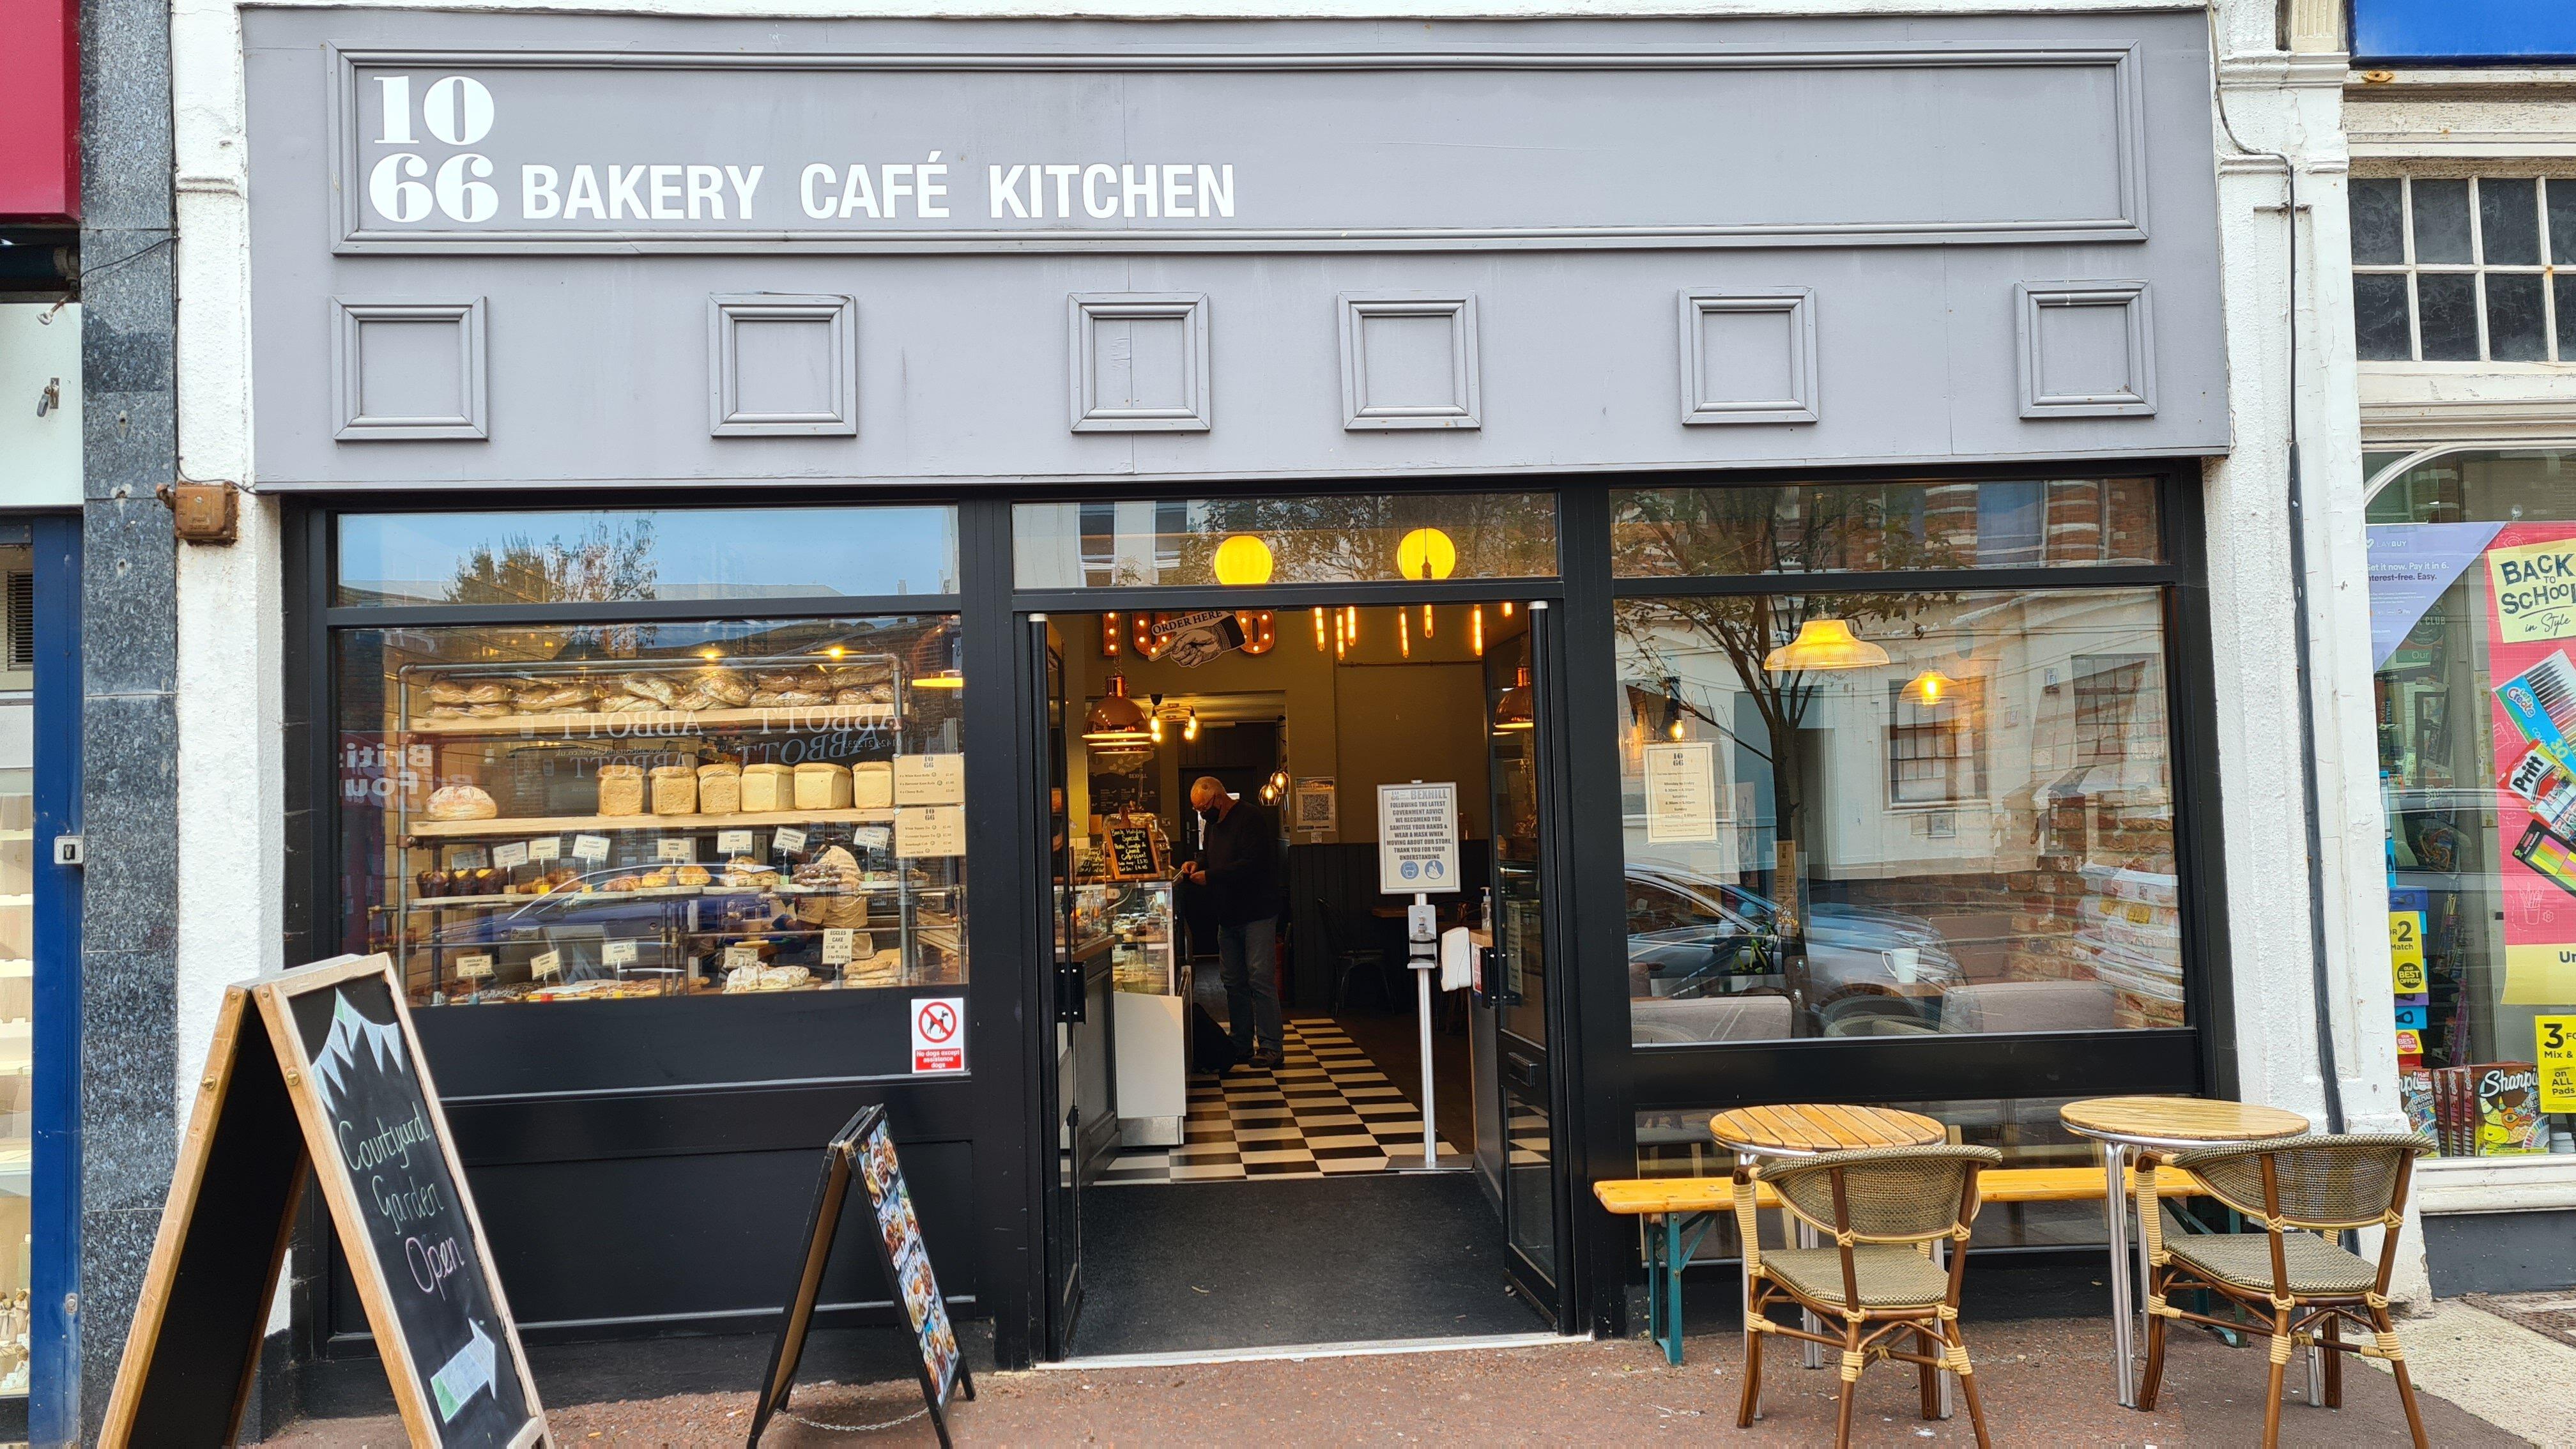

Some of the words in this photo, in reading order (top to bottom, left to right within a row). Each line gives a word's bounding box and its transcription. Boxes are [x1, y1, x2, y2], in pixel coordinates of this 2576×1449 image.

[374, 75, 494, 146] 10
[369, 153, 499, 223] 66
[523, 164, 764, 220] BAKERY
[801, 150, 950, 220] CAFÉ
[989, 164, 1235, 219] KITCHEN
[2368, 572, 2415, 581] nterest-free.
[2417, 572, 2437, 581] Easy.
[2409, 562, 2423, 571] Pay
[2499, 553, 2575, 586] BACK
[1153, 616, 1192, 634] ORDER
[1193, 610, 1223, 624] HERE
[2425, 617, 2446, 625] CLUB
[2525, 624, 2538, 632] in
[2541, 613, 2572, 636] Style
[2412, 651, 2430, 659] Our
[2508, 687, 2535, 717] Create
[2513, 755, 2545, 793] Pritt
[1411, 789, 1447, 800] BEXHILL
[2397, 921, 2413, 942] 2
[2399, 970, 2420, 978] BEST
[2543, 1023, 2564, 1050] 3
[2544, 1050, 2563, 1059] Mix
[2566, 1050, 2573, 1059] &
[2551, 1077, 2574, 1087] ALL
[2552, 1087, 2575, 1096] Pads
[338, 1101, 430, 1171] Courtyard
[371, 1174, 444, 1236] Garden
[405, 1236, 464, 1301] Open
